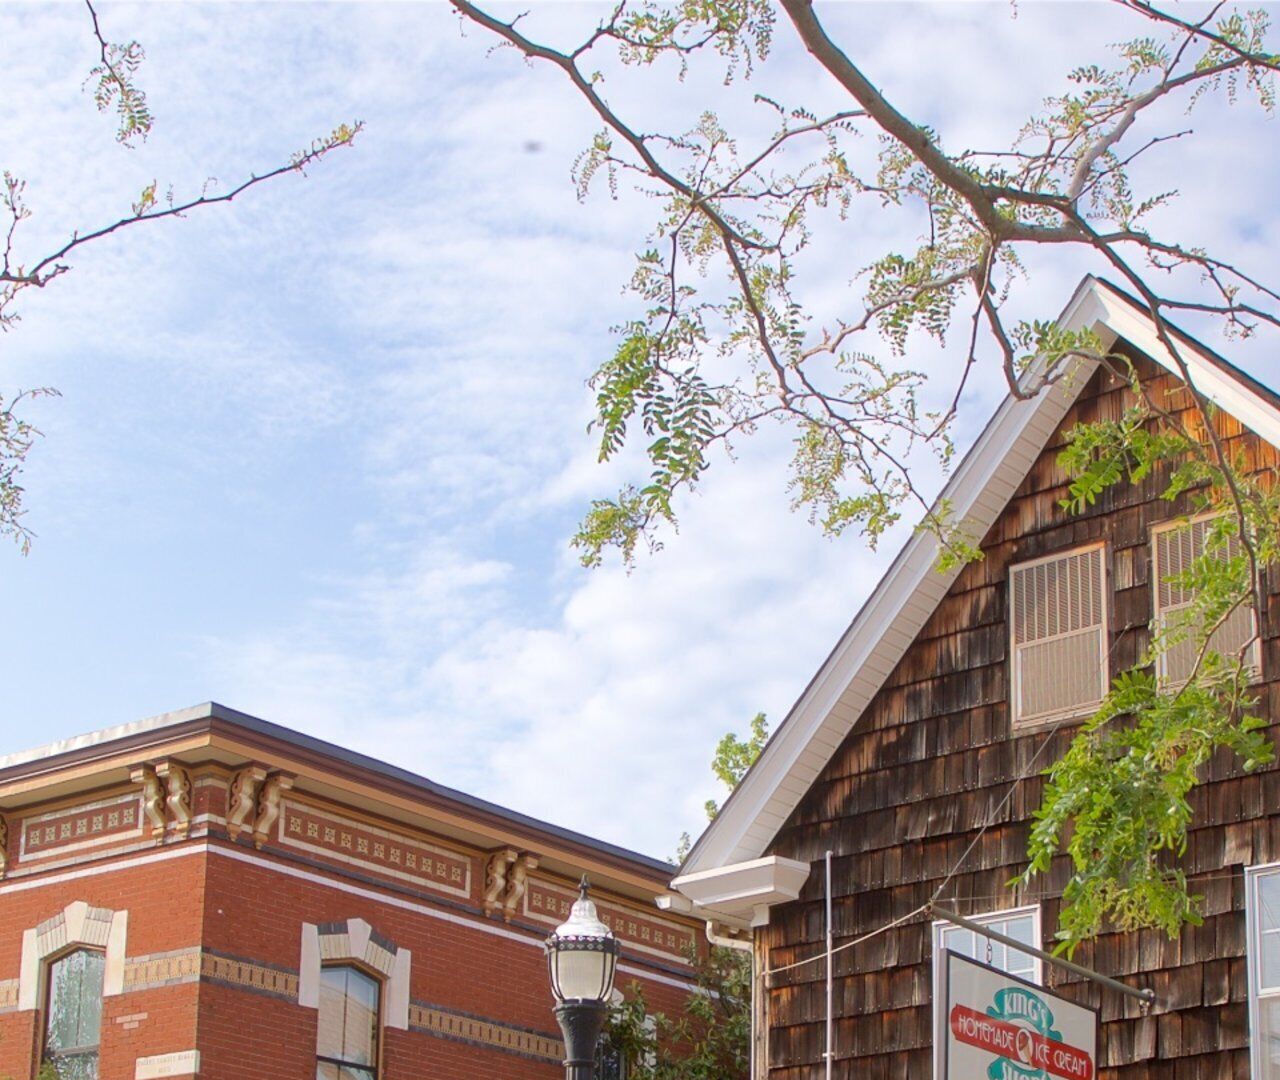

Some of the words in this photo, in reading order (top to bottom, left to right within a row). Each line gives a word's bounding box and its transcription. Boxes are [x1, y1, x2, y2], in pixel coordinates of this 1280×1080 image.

[1003, 993, 1047, 1028] KING'S
[958, 1014, 1014, 1051] HOMEMADE
[1035, 1042, 1050, 1064] ICE
[1053, 1050, 1087, 1077] CREAM
